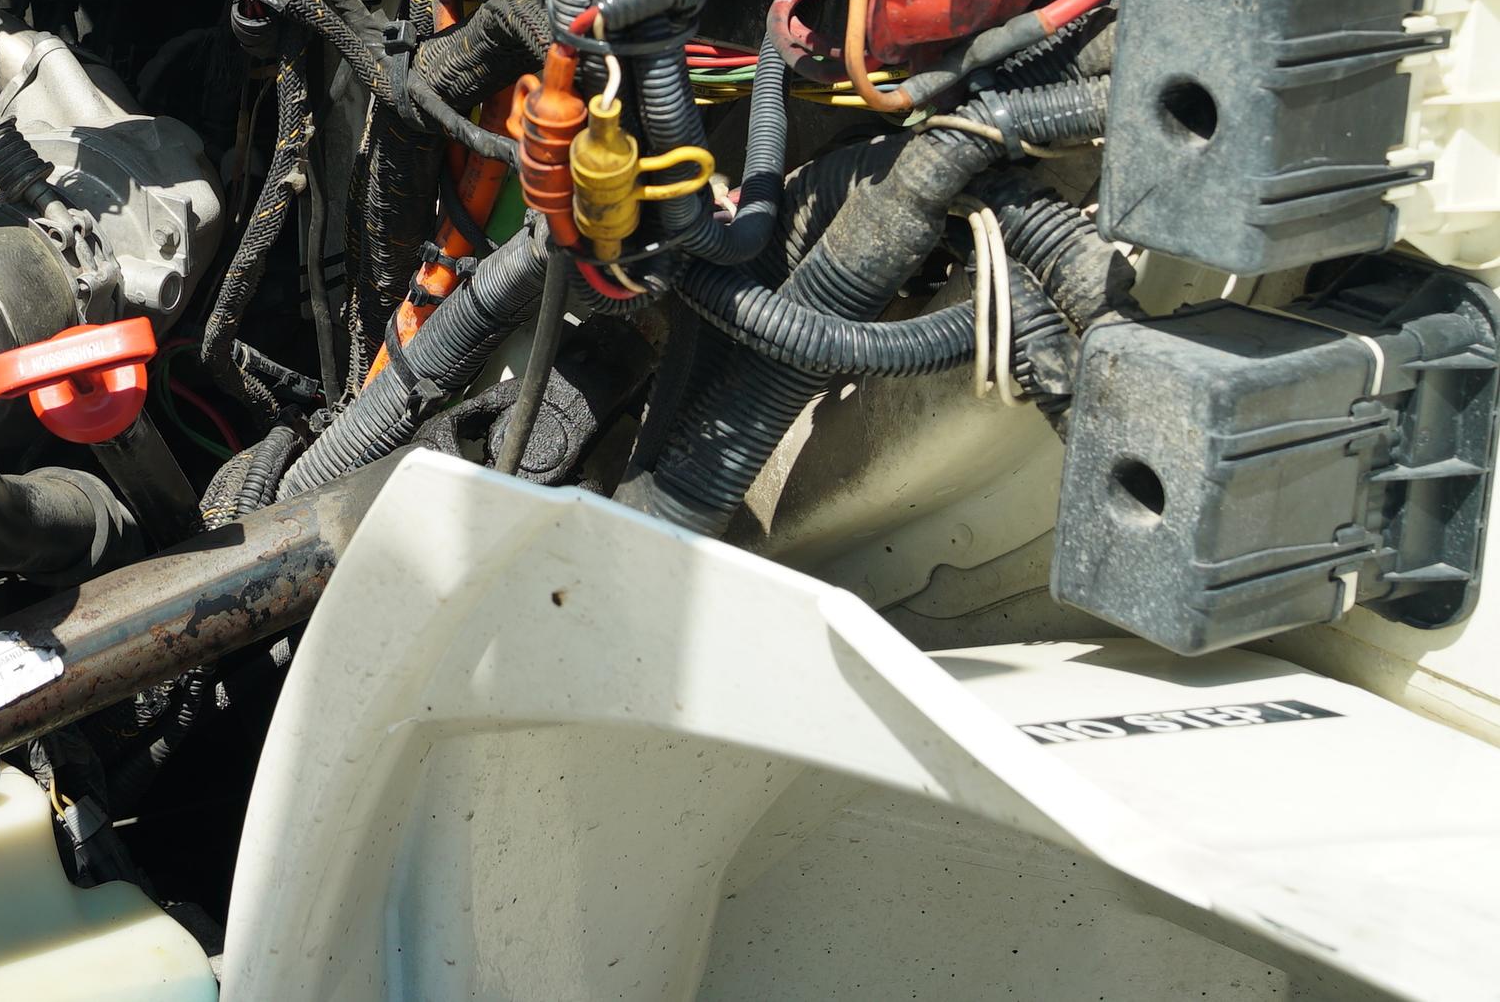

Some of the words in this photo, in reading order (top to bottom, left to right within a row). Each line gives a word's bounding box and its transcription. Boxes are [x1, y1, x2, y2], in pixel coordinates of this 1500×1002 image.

[31, 340, 106, 374] TRANSMISSION
[1020, 719, 1127, 744] NO
[1122, 704, 1265, 734] STEP
